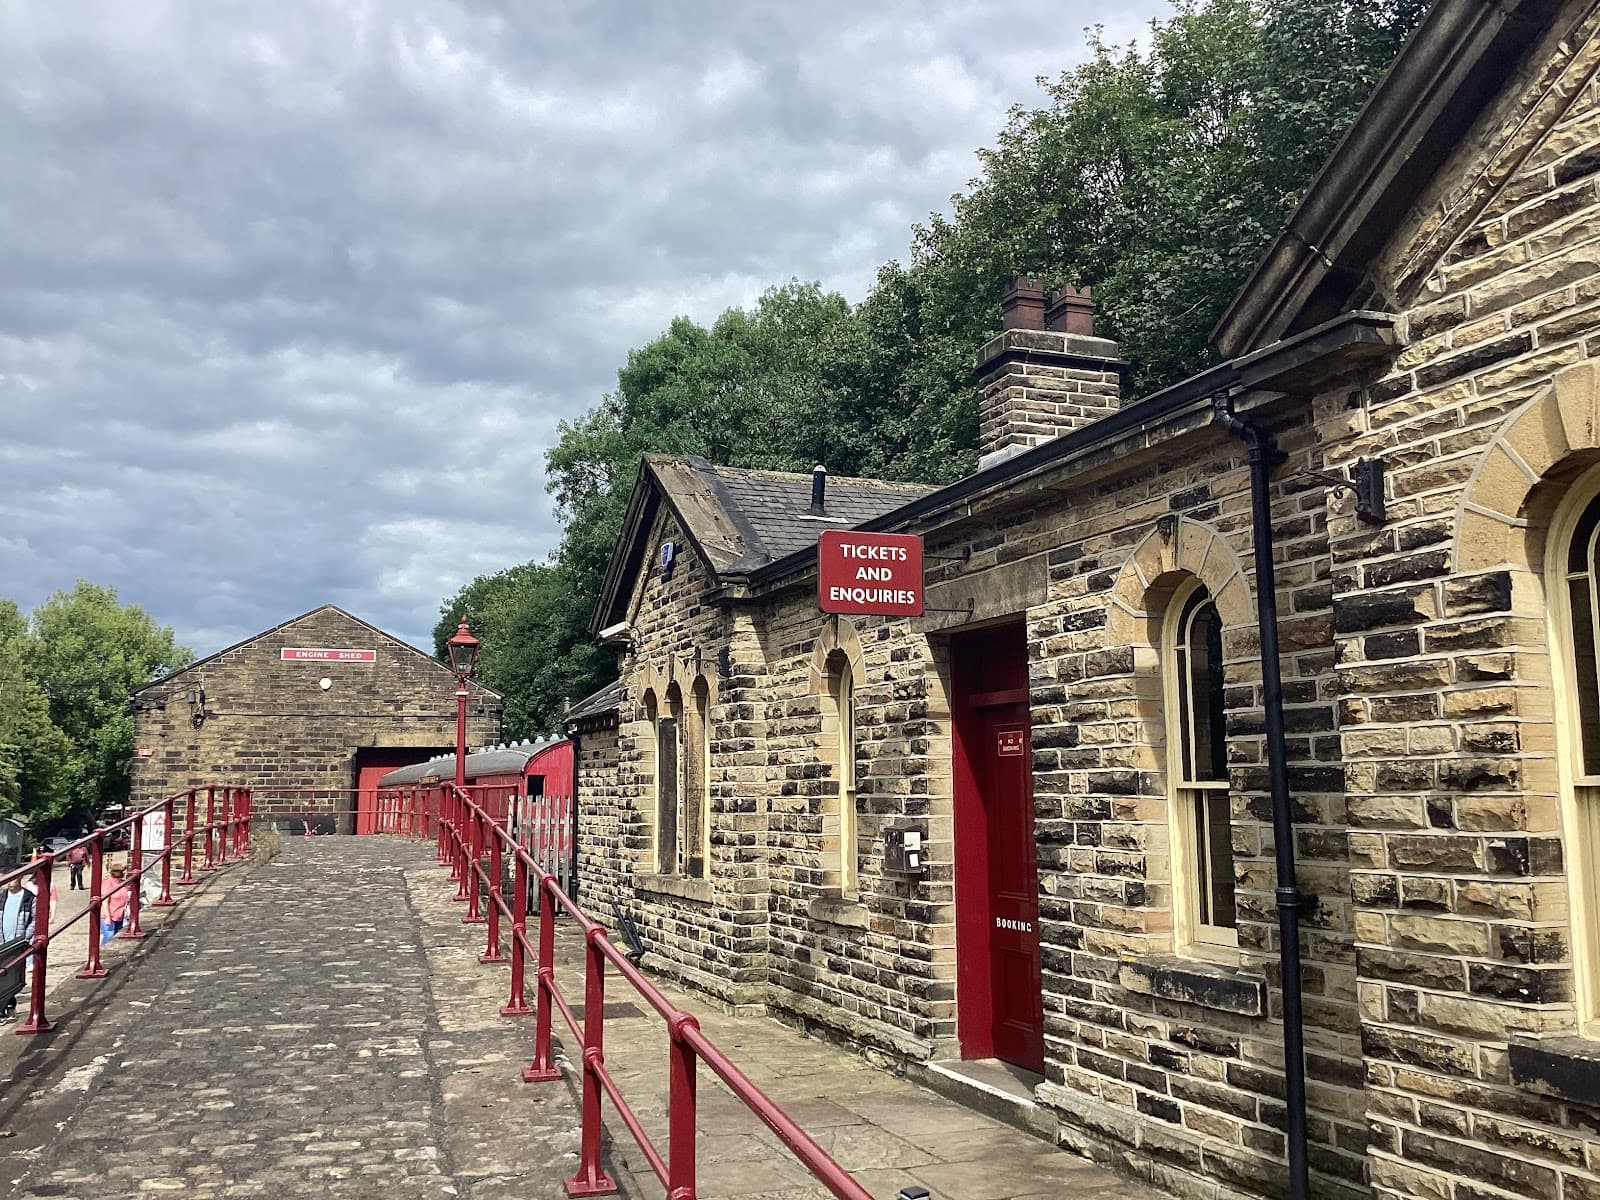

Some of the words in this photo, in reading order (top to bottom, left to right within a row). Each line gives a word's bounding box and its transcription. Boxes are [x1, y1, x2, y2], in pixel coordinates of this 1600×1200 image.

[840, 544, 907, 561] TICKETS
[855, 566, 892, 581] AND
[830, 586, 915, 605] ENQUIRIES
[996, 917, 1032, 932] BOOKING
